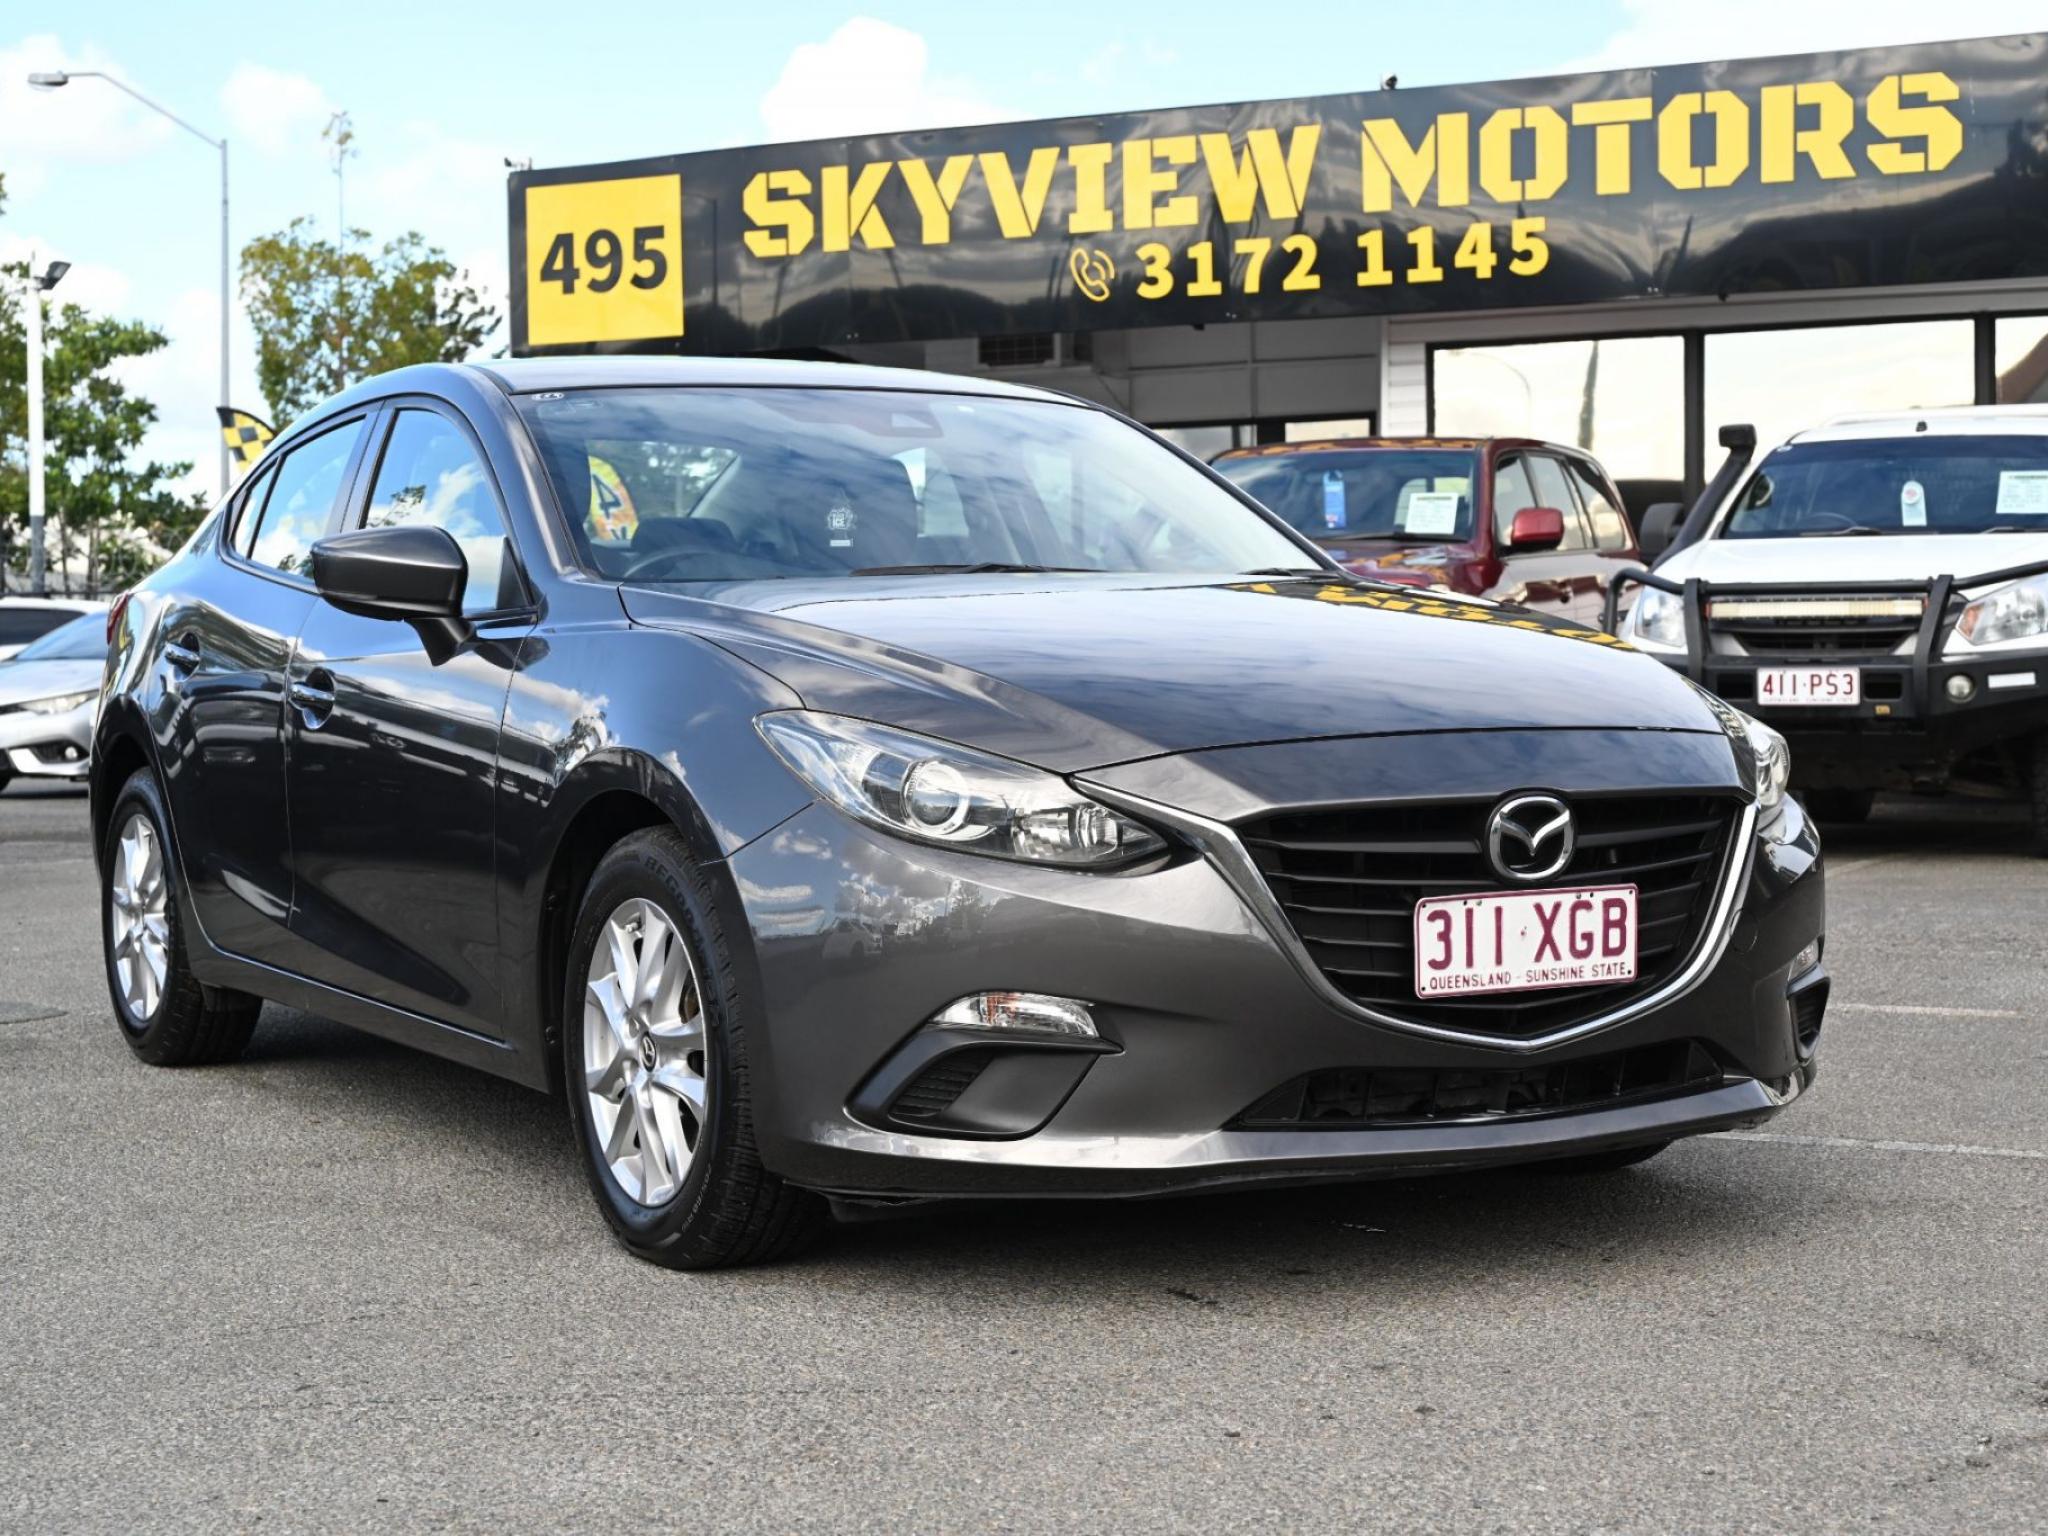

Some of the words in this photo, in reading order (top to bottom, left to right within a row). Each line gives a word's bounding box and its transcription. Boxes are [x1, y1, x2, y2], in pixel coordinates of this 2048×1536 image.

[743, 123, 1322, 258] SKYVIEW
[1361, 72, 1963, 213] MOTORS
[540, 226, 668, 294] 495
[1136, 234, 1321, 299] 3172
[1357, 216, 1549, 286] 1145
[1763, 674, 1796, 695] 411
[1810, 673, 1853, 695] PS3
[1427, 906, 1503, 970] 311
[1533, 898, 1628, 963] XGB
[1429, 971, 1511, 990] QUEENSLAND
[1526, 965, 1585, 983] SUNSHINE
[1592, 961, 1626, 978] STATE
